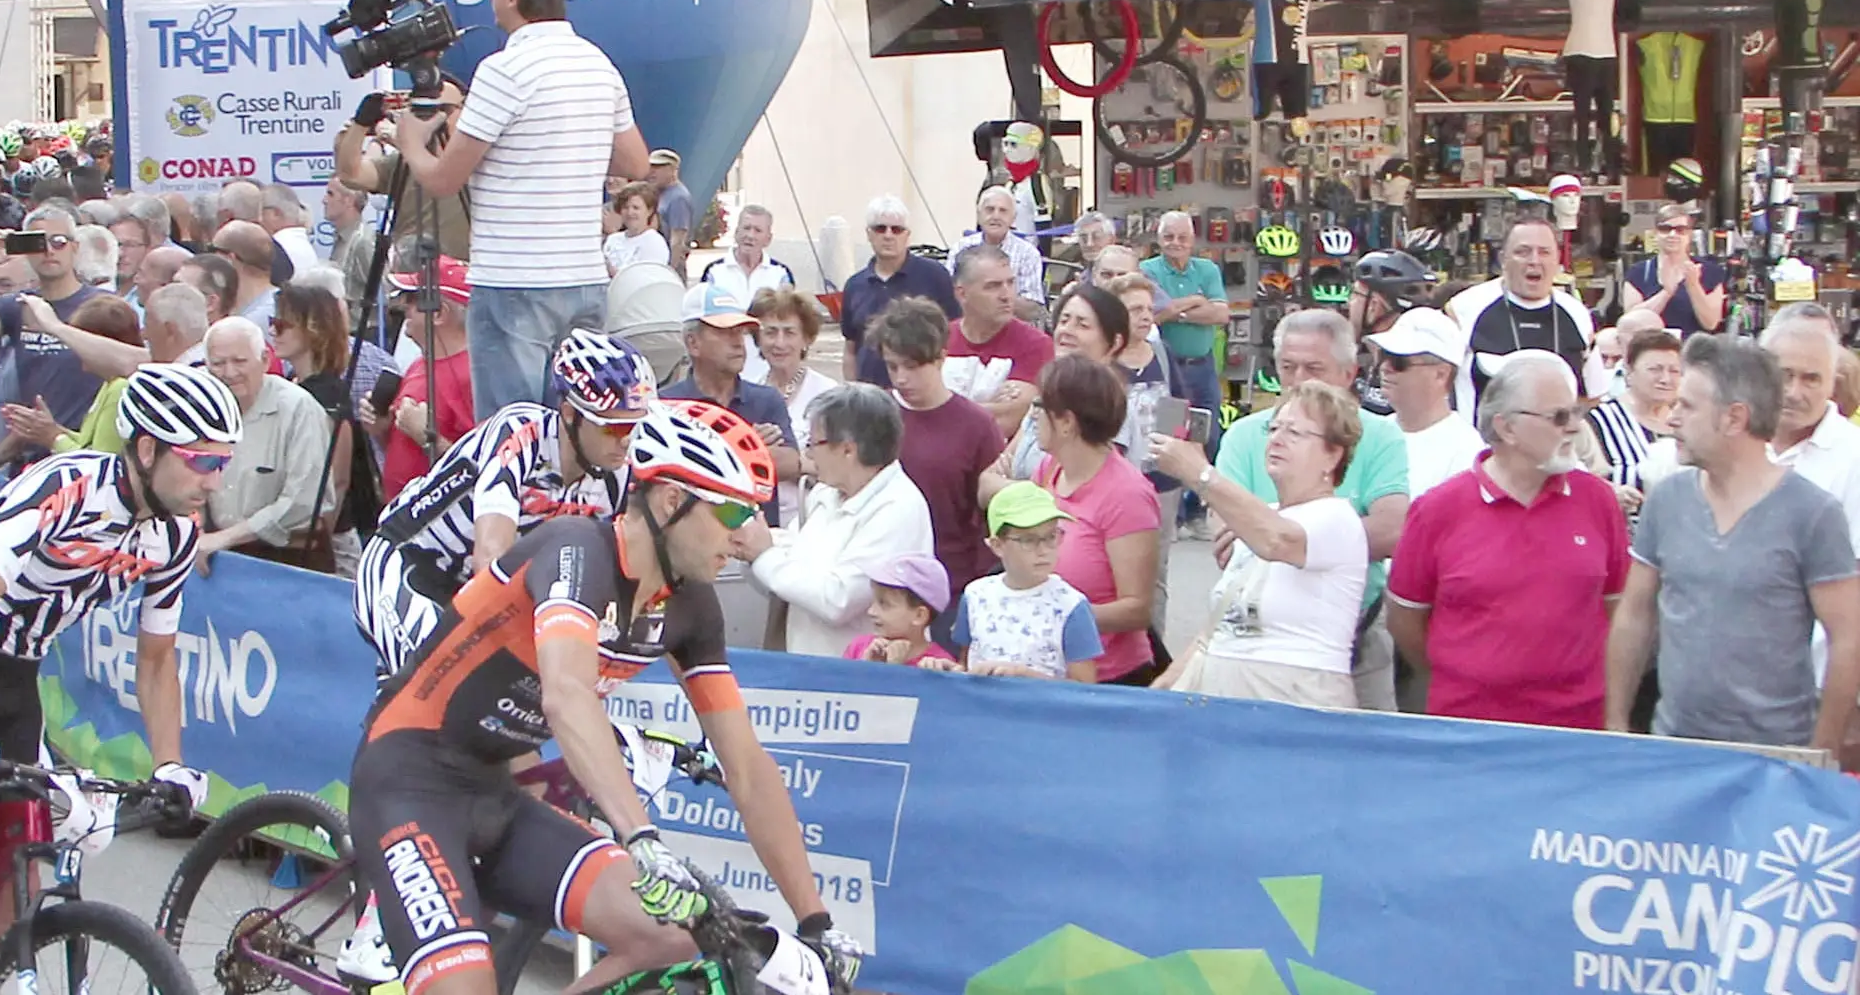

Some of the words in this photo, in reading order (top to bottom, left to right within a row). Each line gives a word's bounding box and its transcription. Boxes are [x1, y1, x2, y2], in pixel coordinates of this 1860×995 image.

[216, 92, 280, 114] Casse
[284, 90, 342, 112] Rurali
[234, 113, 326, 136] Trentine
[161, 156, 257, 179] CONAD
[409, 467, 474, 520] PROTEK
[81, 605, 278, 737] TRETINO
[664, 693, 690, 723] di
[748, 693, 862, 736] mpiglio
[780, 759, 823, 799] aly
[714, 861, 778, 893] June
[1529, 827, 1723, 880] MADONNA
[1722, 848, 1750, 886] DI
[384, 837, 458, 941] ANDREIS
[415, 833, 474, 927] CICLI
